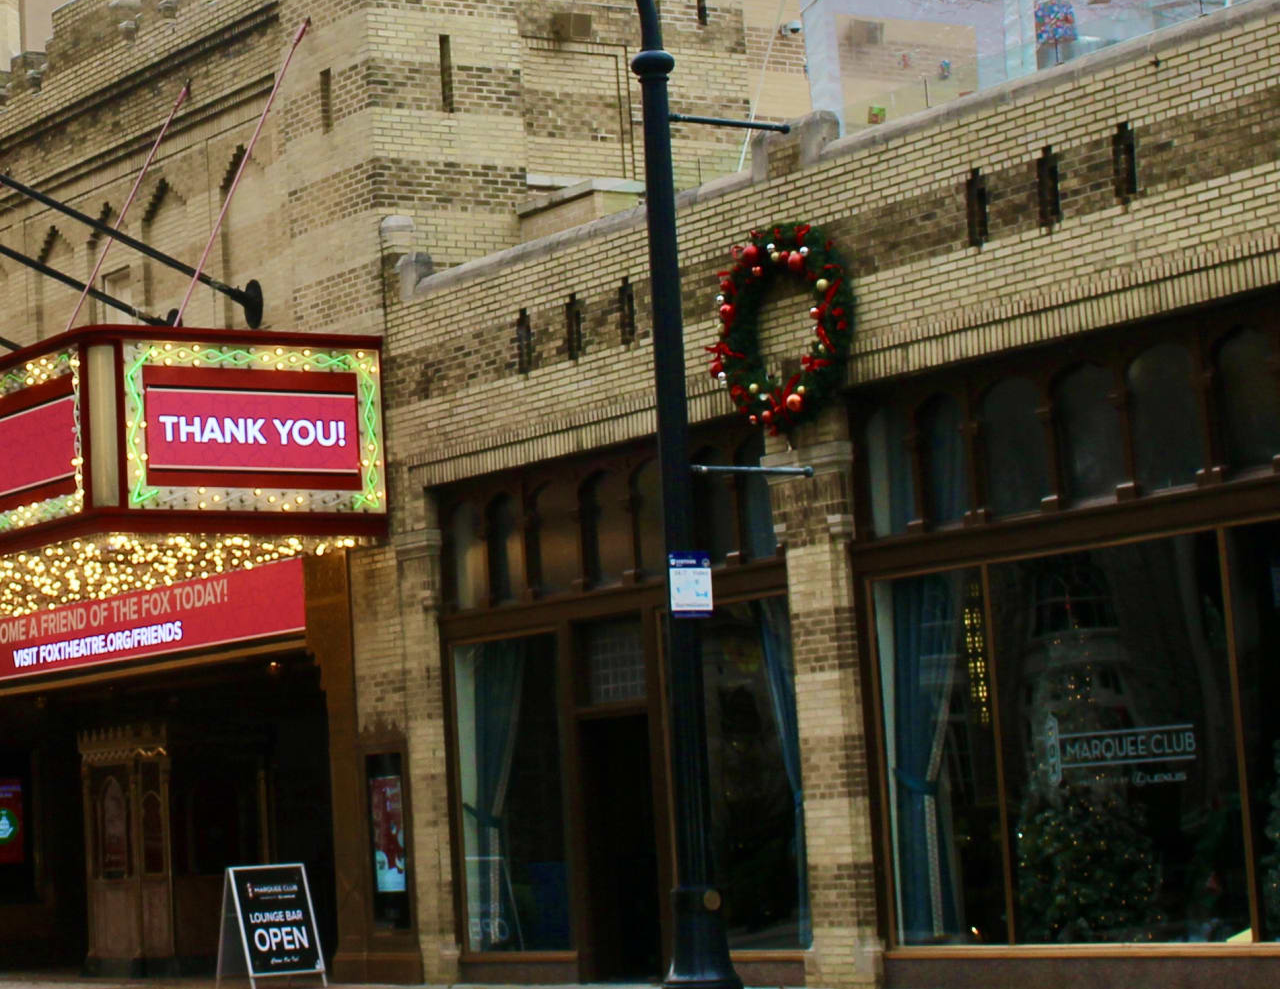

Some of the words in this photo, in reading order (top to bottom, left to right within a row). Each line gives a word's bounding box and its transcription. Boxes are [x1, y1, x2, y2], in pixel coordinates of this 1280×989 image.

[159, 415, 267, 444] THANK
[272, 418, 346, 447] YOU!
[29, 619, 39, 637] A
[41, 609, 87, 636] FRIEND
[90, 604, 109, 627] OF
[111, 597, 138, 623] THE
[142, 590, 170, 616] FOX
[173, 579, 229, 611] TODAY!
[13, 646, 39, 668] VISIT
[39, 620, 183, 663] FOXTHEATRE.ORG/FRIENDS
[1065, 735, 1148, 759] MARQUEE
[1151, 731, 1197, 754] CLUB
[249, 910, 285, 924] LOUNGE
[285, 909, 303, 921] BAR
[254, 925, 309, 952] OPEN
